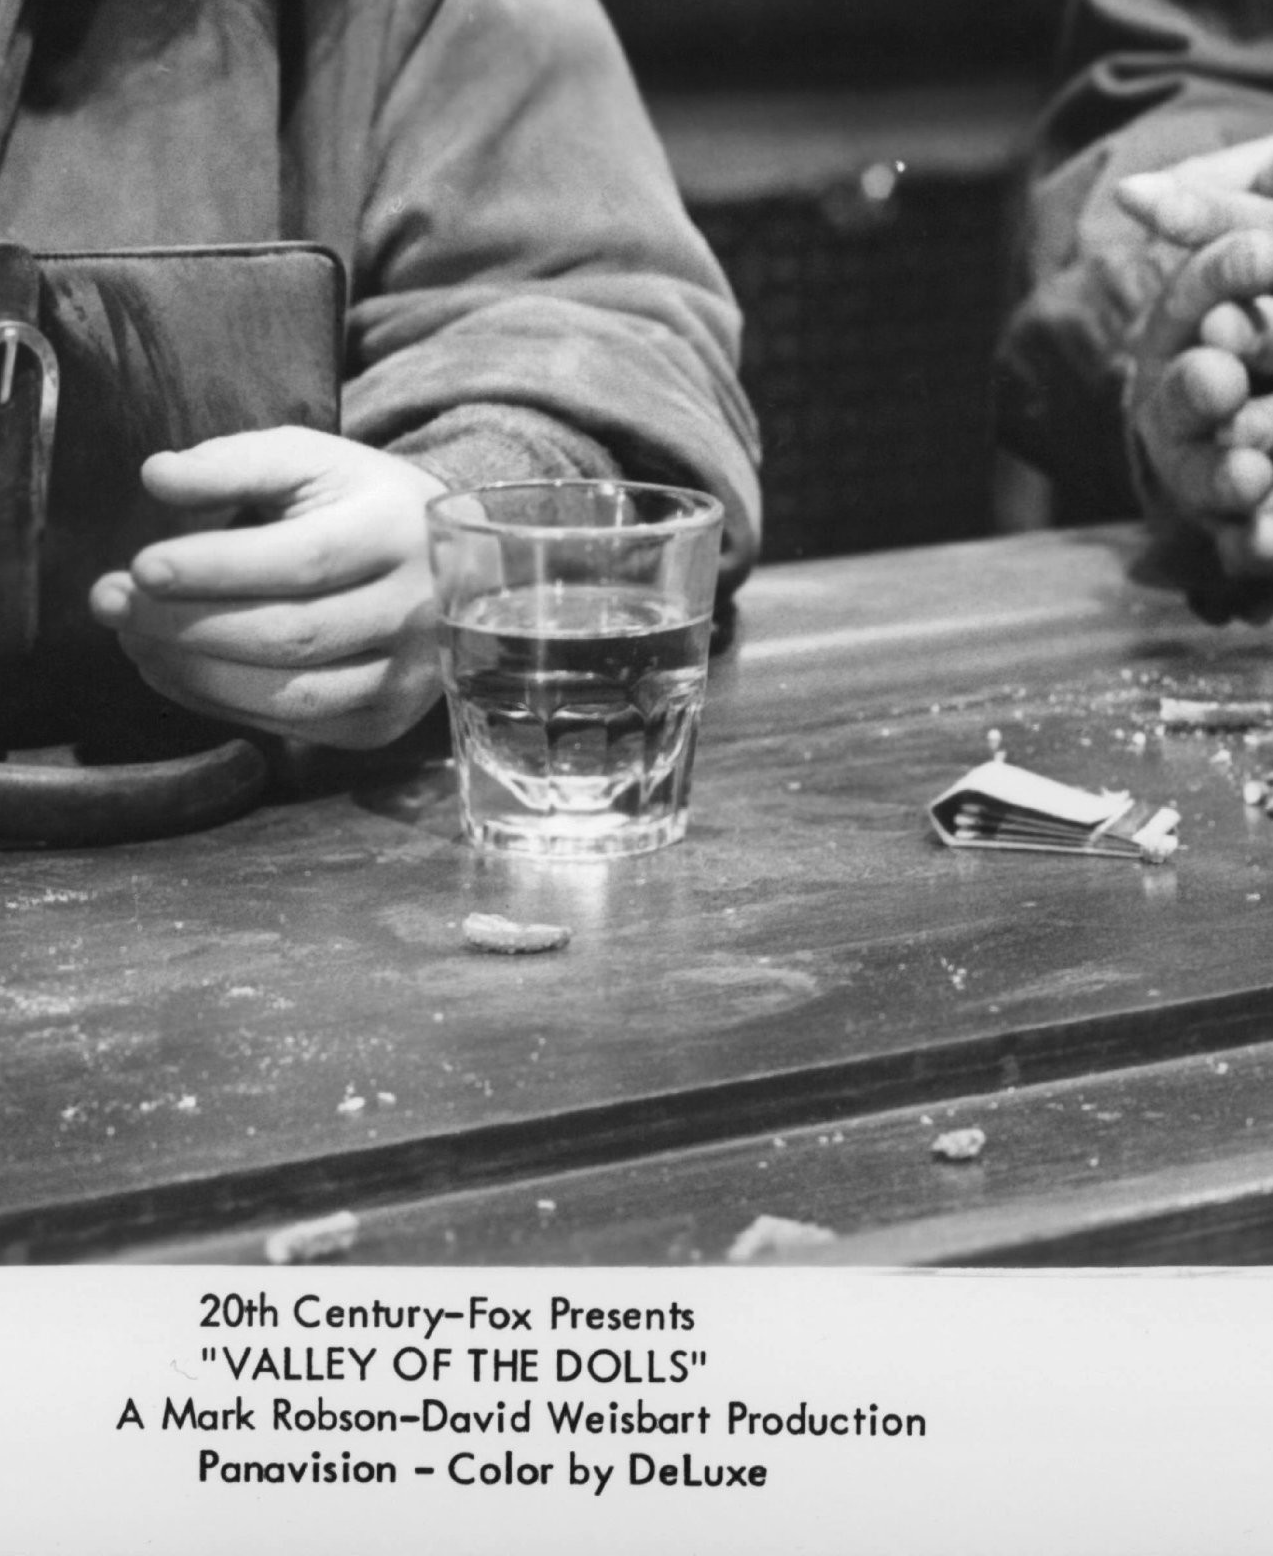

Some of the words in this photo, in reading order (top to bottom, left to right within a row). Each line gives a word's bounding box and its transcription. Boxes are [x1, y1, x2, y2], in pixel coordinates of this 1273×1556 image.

[199, 1291, 279, 1328] 20th
[293, 1294, 532, 1340] Century-Fox
[550, 1296, 695, 1331] Presents
[201, 1346, 377, 1382] "VALLEY
[392, 1346, 453, 1382] OF
[467, 1348, 539, 1383] THE
[556, 1348, 707, 1384] DOLLS"
[115, 1397, 145, 1430] A
[161, 1395, 256, 1432] Mark
[273, 1396, 532, 1434] Robson-David
[546, 1398, 711, 1435] Weisbart
[728, 1400, 926, 1437] Production
[199, 1449, 397, 1484] Panavision
[447, 1450, 554, 1486] Color
[569, 1450, 615, 1497] by
[629, 1452, 768, 1488] DeLuxe
